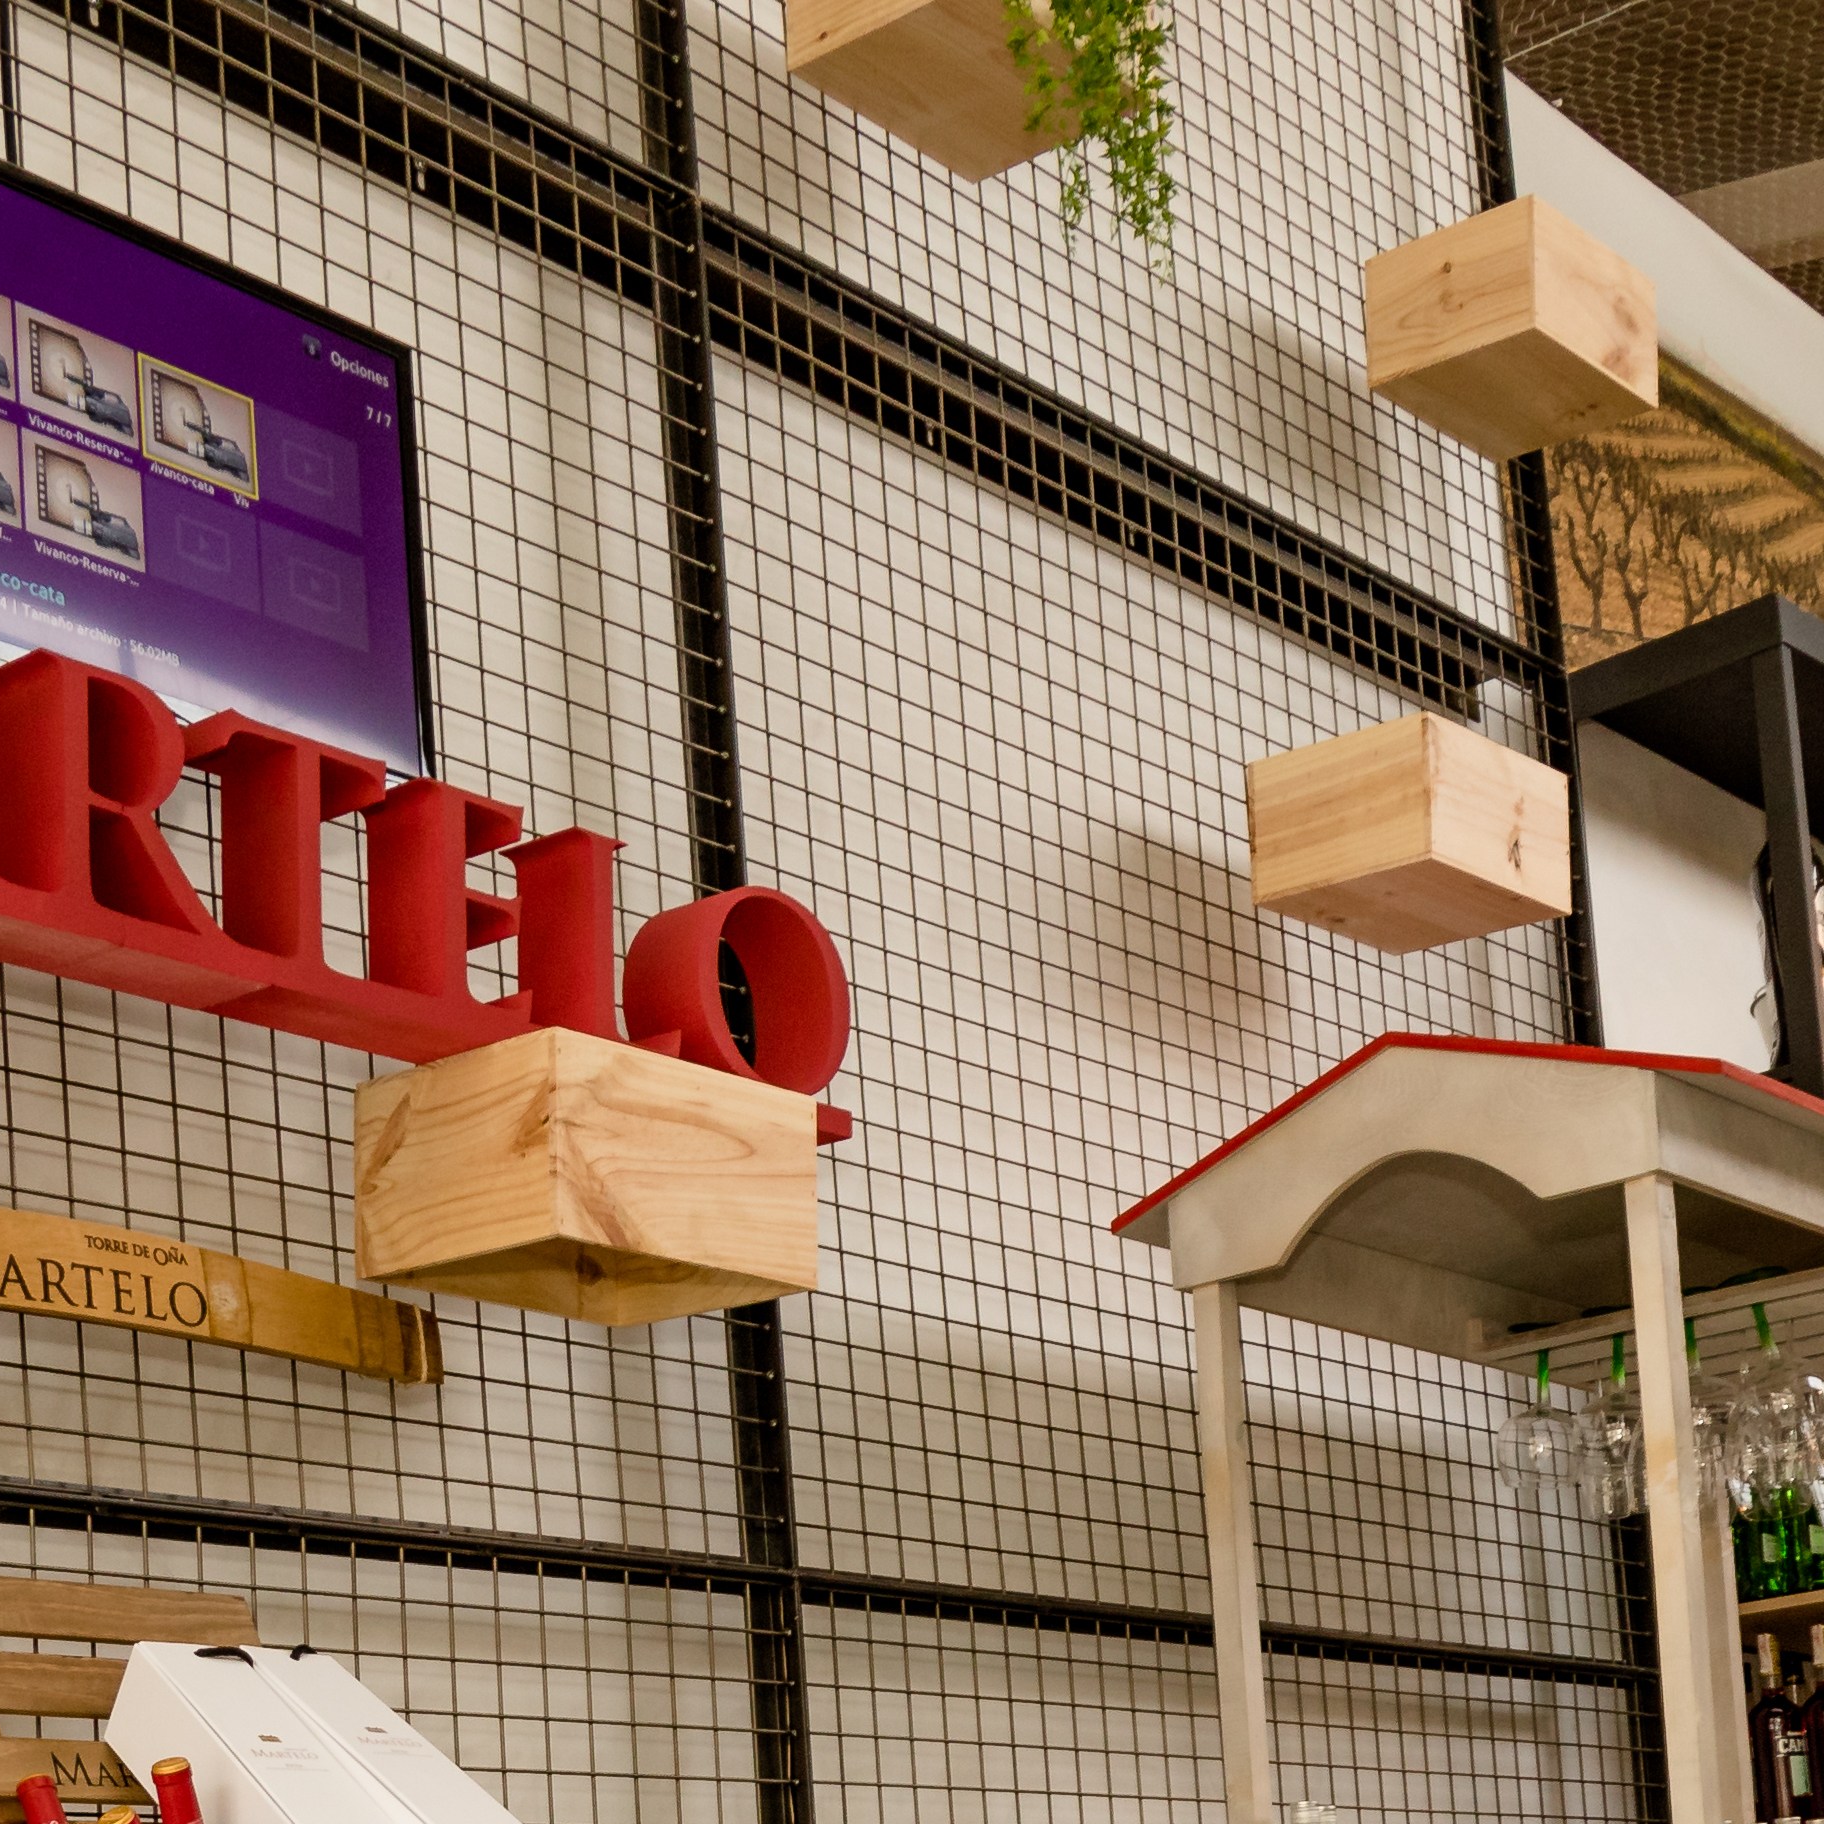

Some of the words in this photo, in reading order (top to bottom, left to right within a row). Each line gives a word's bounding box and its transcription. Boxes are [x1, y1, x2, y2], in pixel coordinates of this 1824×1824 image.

[331, 351, 389, 388] Opciones
[84, 1234, 128, 1257] TORRE
[131, 1242, 151, 1260] DE
[152, 1244, 189, 1267] OÑA
